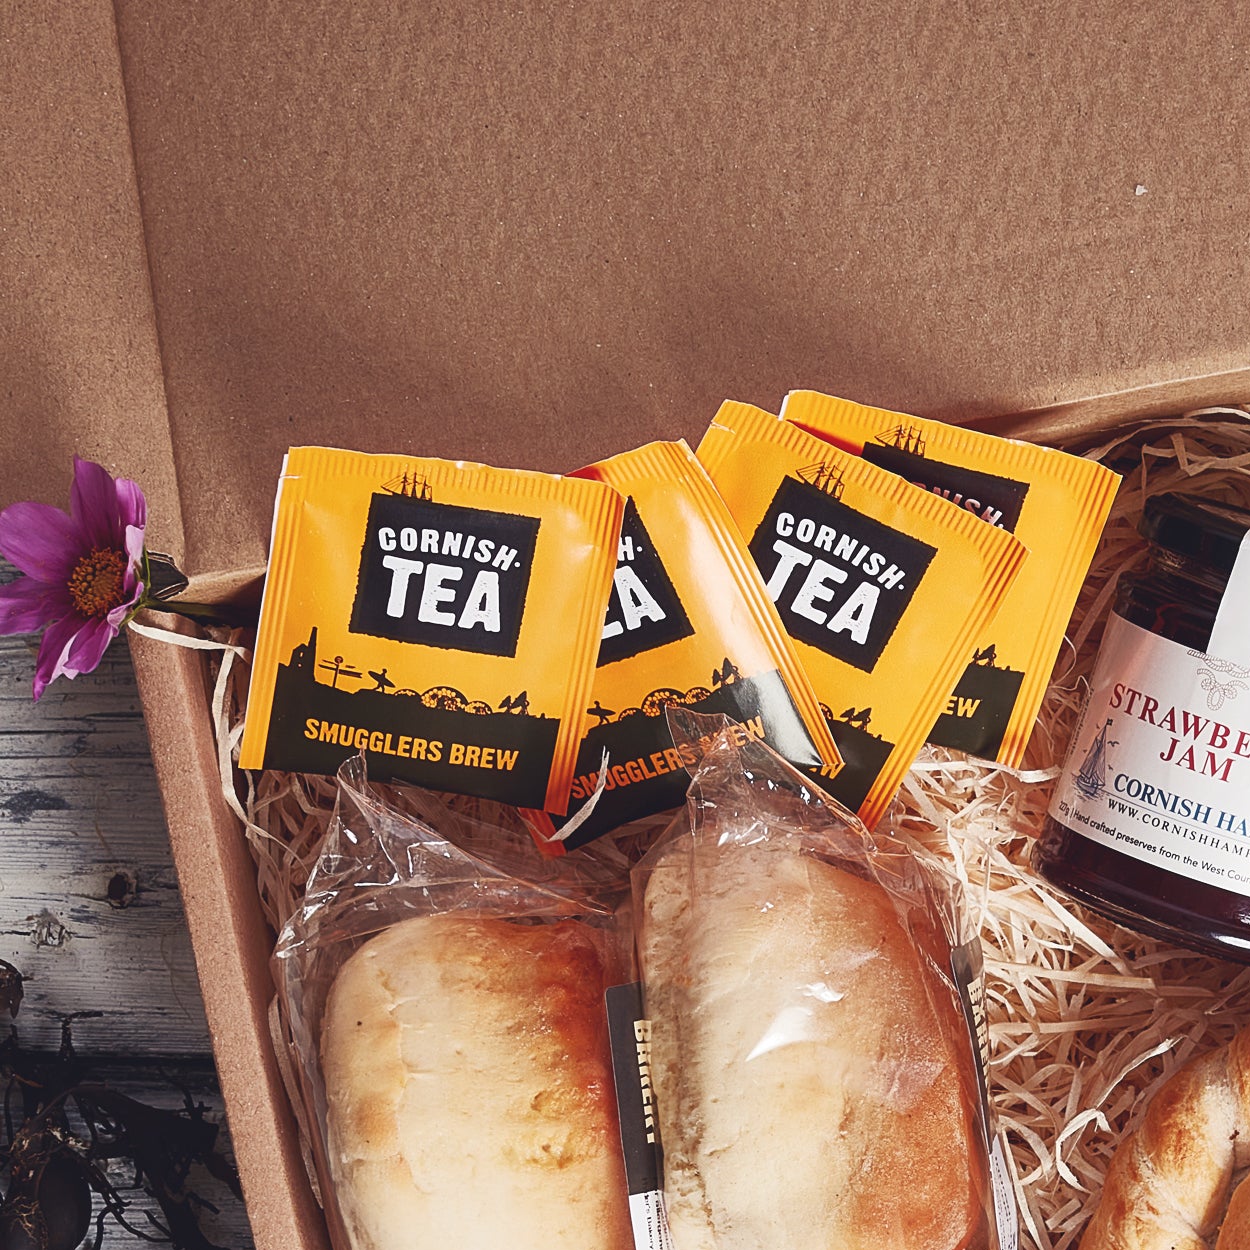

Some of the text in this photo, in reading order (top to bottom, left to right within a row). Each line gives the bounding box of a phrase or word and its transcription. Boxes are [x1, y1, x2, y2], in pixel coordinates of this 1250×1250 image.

[381, 555, 501, 633] TEA
[767, 539, 880, 645] TEA
[303, 718, 519, 771] SMUGGLERS BREW
[1159, 736, 1237, 783] JAM
[1113, 773, 1212, 825] CORNISH
[1089, 820, 1116, 837] crafted
[1115, 831, 1157, 853] preserves
[1158, 846, 1181, 862] from
[1182, 856, 1198, 868] the
[1200, 860, 1225, 876] West
